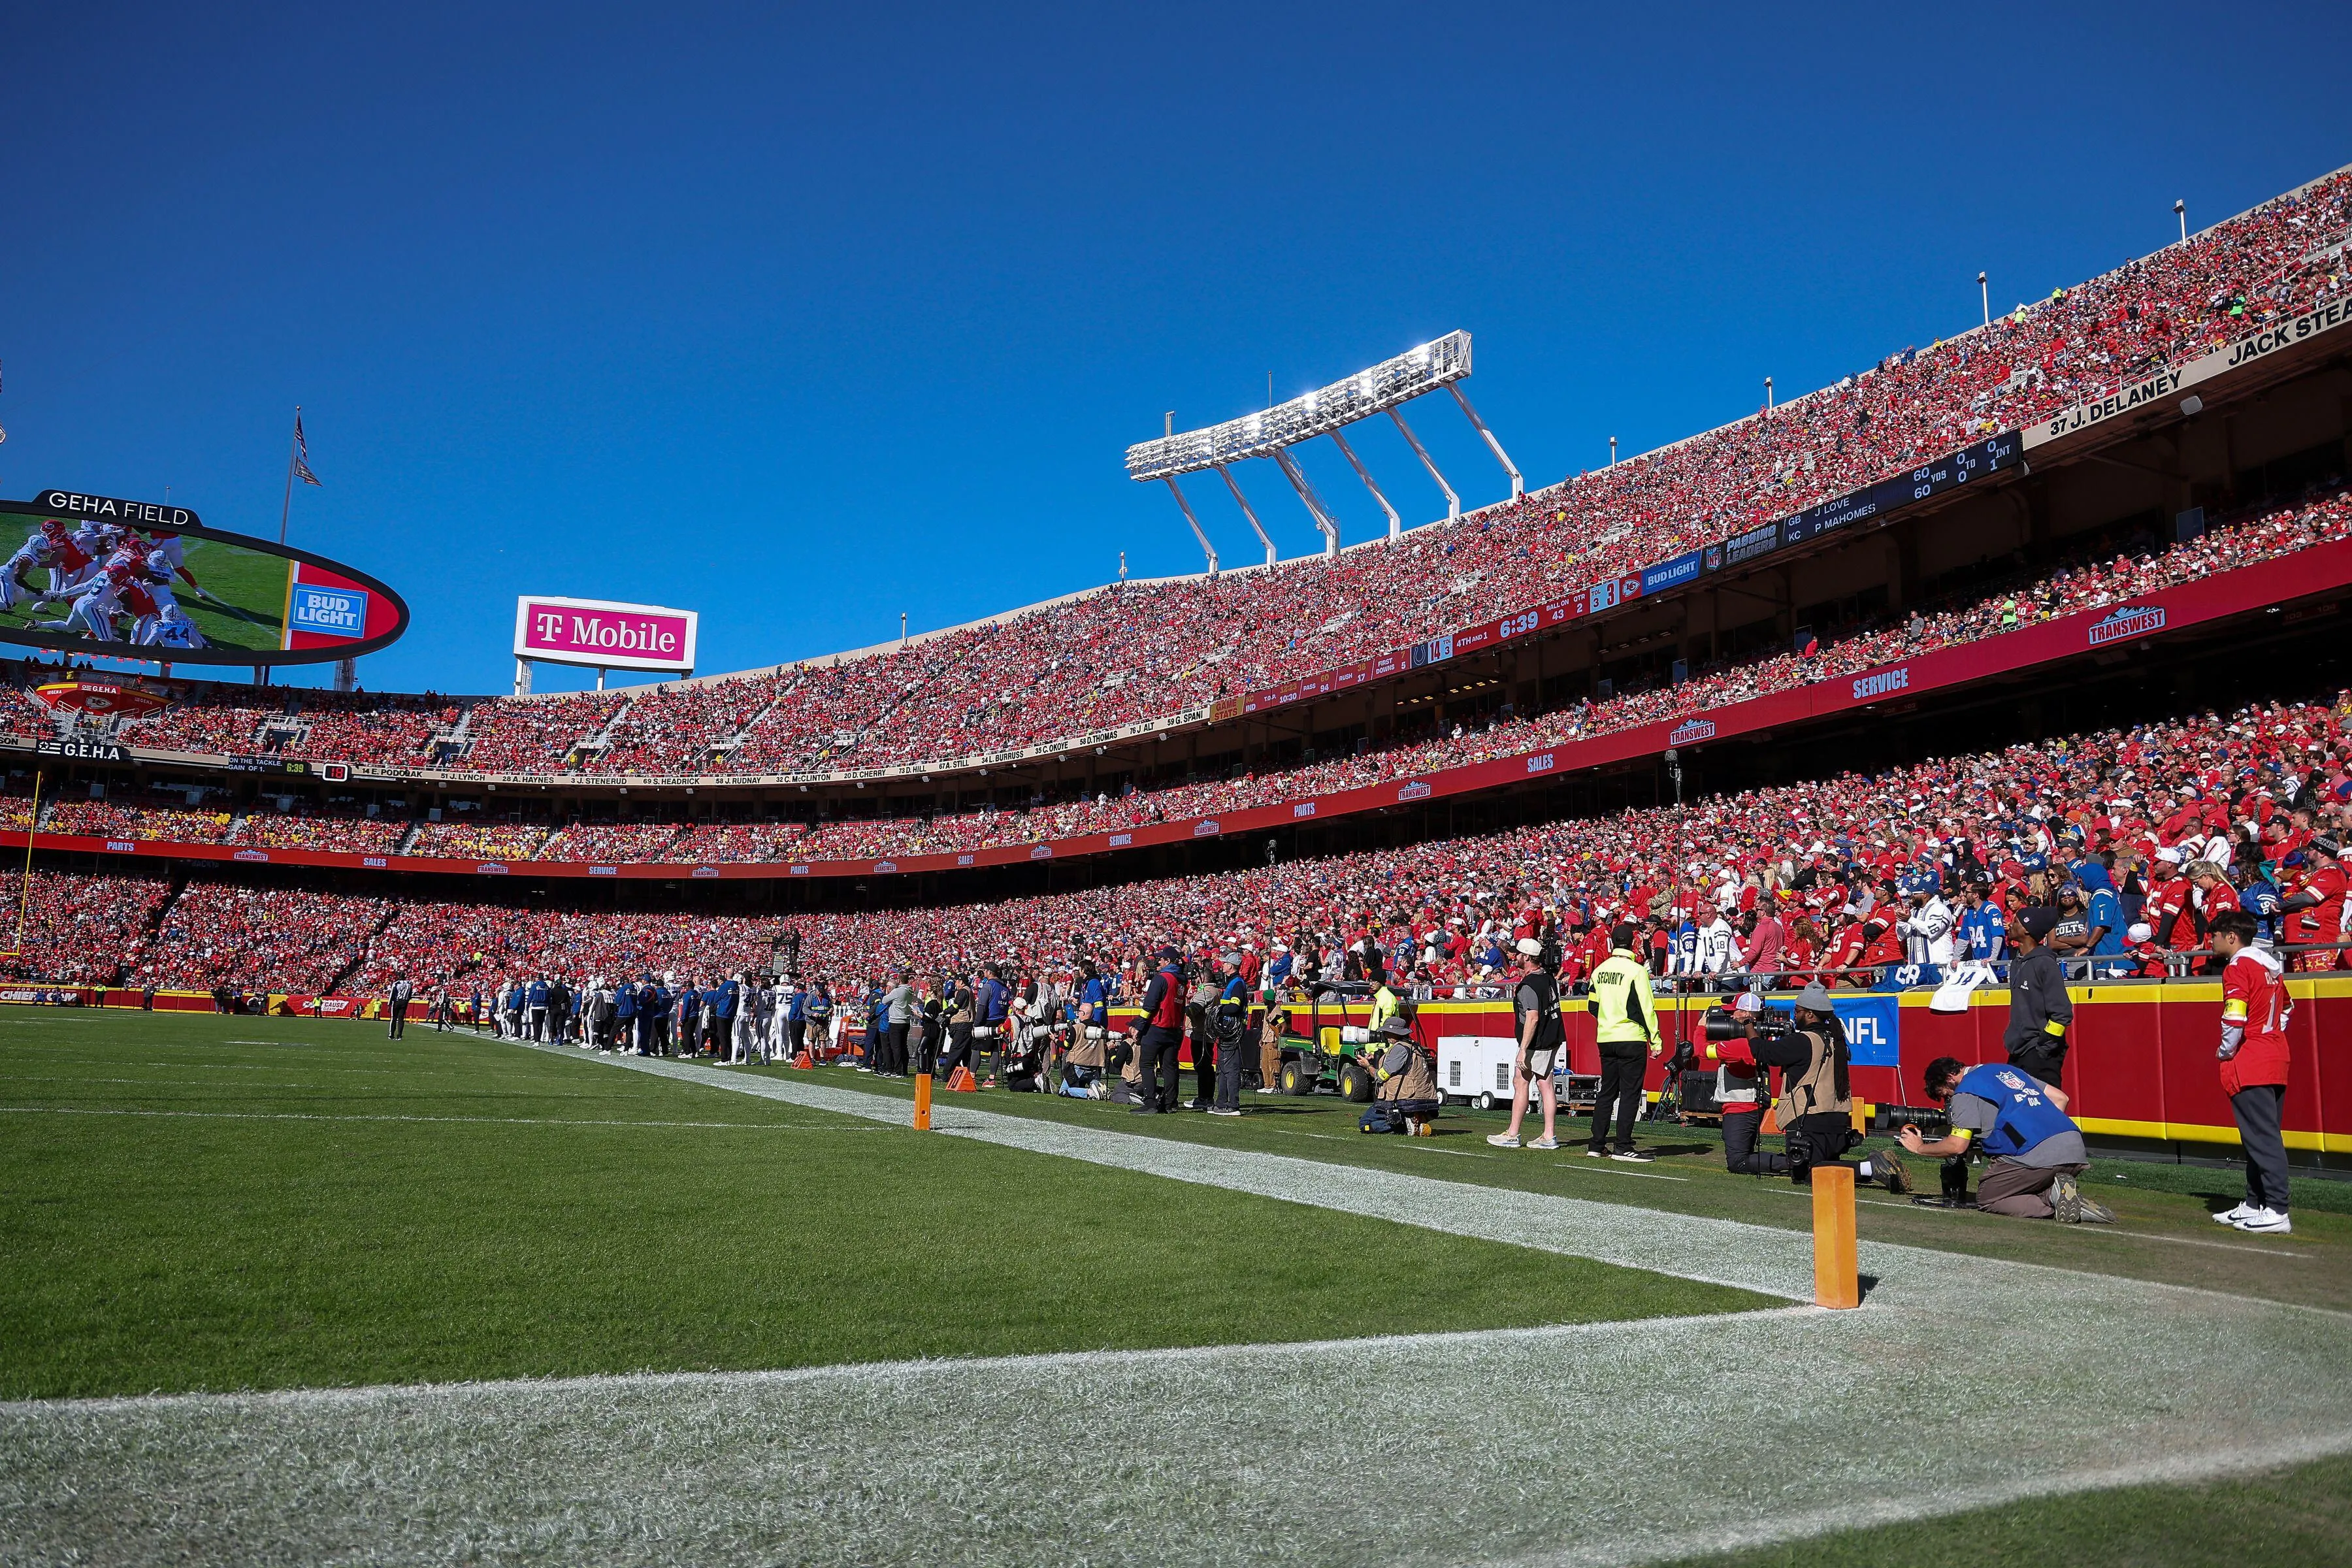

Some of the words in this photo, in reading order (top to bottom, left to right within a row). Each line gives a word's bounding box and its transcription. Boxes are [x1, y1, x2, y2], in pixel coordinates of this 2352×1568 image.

[2228, 325, 2291, 366] JACK
[2050, 417, 2067, 436] 37
[2070, 410, 2086, 429] J.
[2090, 370, 2182, 420] DELANEY
[1987, 440, 1996, 453] 0
[1995, 444, 2011, 459] INT
[1957, 453, 1965, 465] 0
[1965, 458, 1976, 470] TD
[1990, 459, 1997, 472] 1
[1914, 467, 1929, 482] 60
[1958, 470, 1966, 483] 0
[1914, 484, 1930, 499] 60
[49, 492, 116, 516] GEHA
[124, 502, 188, 525] FIELD
[1788, 515, 1801, 527] GB
[1815, 506, 1820, 517] J
[1824, 498, 1850, 514] LOVE
[1788, 531, 1801, 542] KC
[1815, 523, 1821, 532] P
[1825, 503, 1876, 530] MAHOMES
[1726, 525, 1776, 552] PASSING
[1726, 536, 1776, 564] LEADERS
[1648, 572, 1667, 586] BUD
[1668, 561, 1695, 578] LIGHT
[1573, 593, 1585, 602] QTR
[1607, 582, 1615, 605] 3
[308, 595, 350, 611] BUD
[1546, 601, 1560, 612] BALL
[1561, 598, 1569, 607] ON
[1593, 597, 1599, 607] 3
[1576, 603, 1582, 613] 2
[298, 607, 356, 626] LIGHT
[1552, 609, 1564, 620] 43
[1500, 611, 1539, 638] 6:39
[2090, 610, 2163, 642] TRANSWEST
[164, 626, 190, 641] 44
[537, 613, 563, 642] T
[570, 616, 676, 653] Mobile
[1456, 637, 1471, 647] 4TH
[1429, 641, 1441, 661] 14
[1445, 645, 1450, 655] 3
[1378, 657, 1393, 667] FIRST
[1401, 661, 1405, 670] 5
[1376, 664, 1395, 674] DOWNS
[1339, 672, 1352, 681] RUSH
[1303, 683, 1316, 691] PASS
[1320, 683, 1329, 692] 94
[1853, 668, 1908, 699] SERVICE
[93, 686, 117, 694] G.E.H.A
[1279, 693, 1297, 703] 10:30
[1216, 700, 1235, 711] GAME
[1183, 711, 1203, 723] SPANI
[1214, 708, 1237, 719] STATS
[1143, 722, 1154, 732] ALT
[1092, 730, 1118, 743] THOMAS
[1671, 723, 1714, 744] TRANSWEST
[65, 743, 120, 760] G.E.H.A
[1049, 741, 1068, 752] OKOYE
[995, 751, 1024, 762] BURRUSS
[286, 762, 304, 773] 6:39
[953, 759, 969, 768] STILL
[1527, 753, 1554, 773] SALES
[331, 767, 343, 778] 18
[860, 769, 886, 778] CHERRY
[792, 774, 831, 783] McCLINTON
[1399, 785, 1431, 800] TRANSWEST
[1294, 802, 1315, 817] PARTS
[1194, 825, 1219, 836] TRANSWEST
[1109, 833, 1132, 847] SERVICE
[106, 841, 135, 851] PARTS
[1031, 849, 1051, 858] TRANSWEST
[363, 857, 386, 867] SALES
[958, 855, 973, 866] SALES
[589, 866, 617, 875] SERVICE
[790, 865, 809, 874] PARTS
[874, 864, 896, 873] TRANSWEST
[2099, 910, 2104, 921] 1
[1992, 917, 2002, 926] 84
[1927, 923, 1940, 935] 18
[2055, 923, 2084, 936] COLTS
[1686, 941, 1693, 949] 88
[1716, 941, 1725, 949] 18
[1597, 972, 1625, 986] SECURITY
[777, 993, 792, 1004] 75
[1838, 1017, 1886, 1044] NFL
[792, 1055, 803, 1066] 20
[949, 1069, 963, 1088] 10
